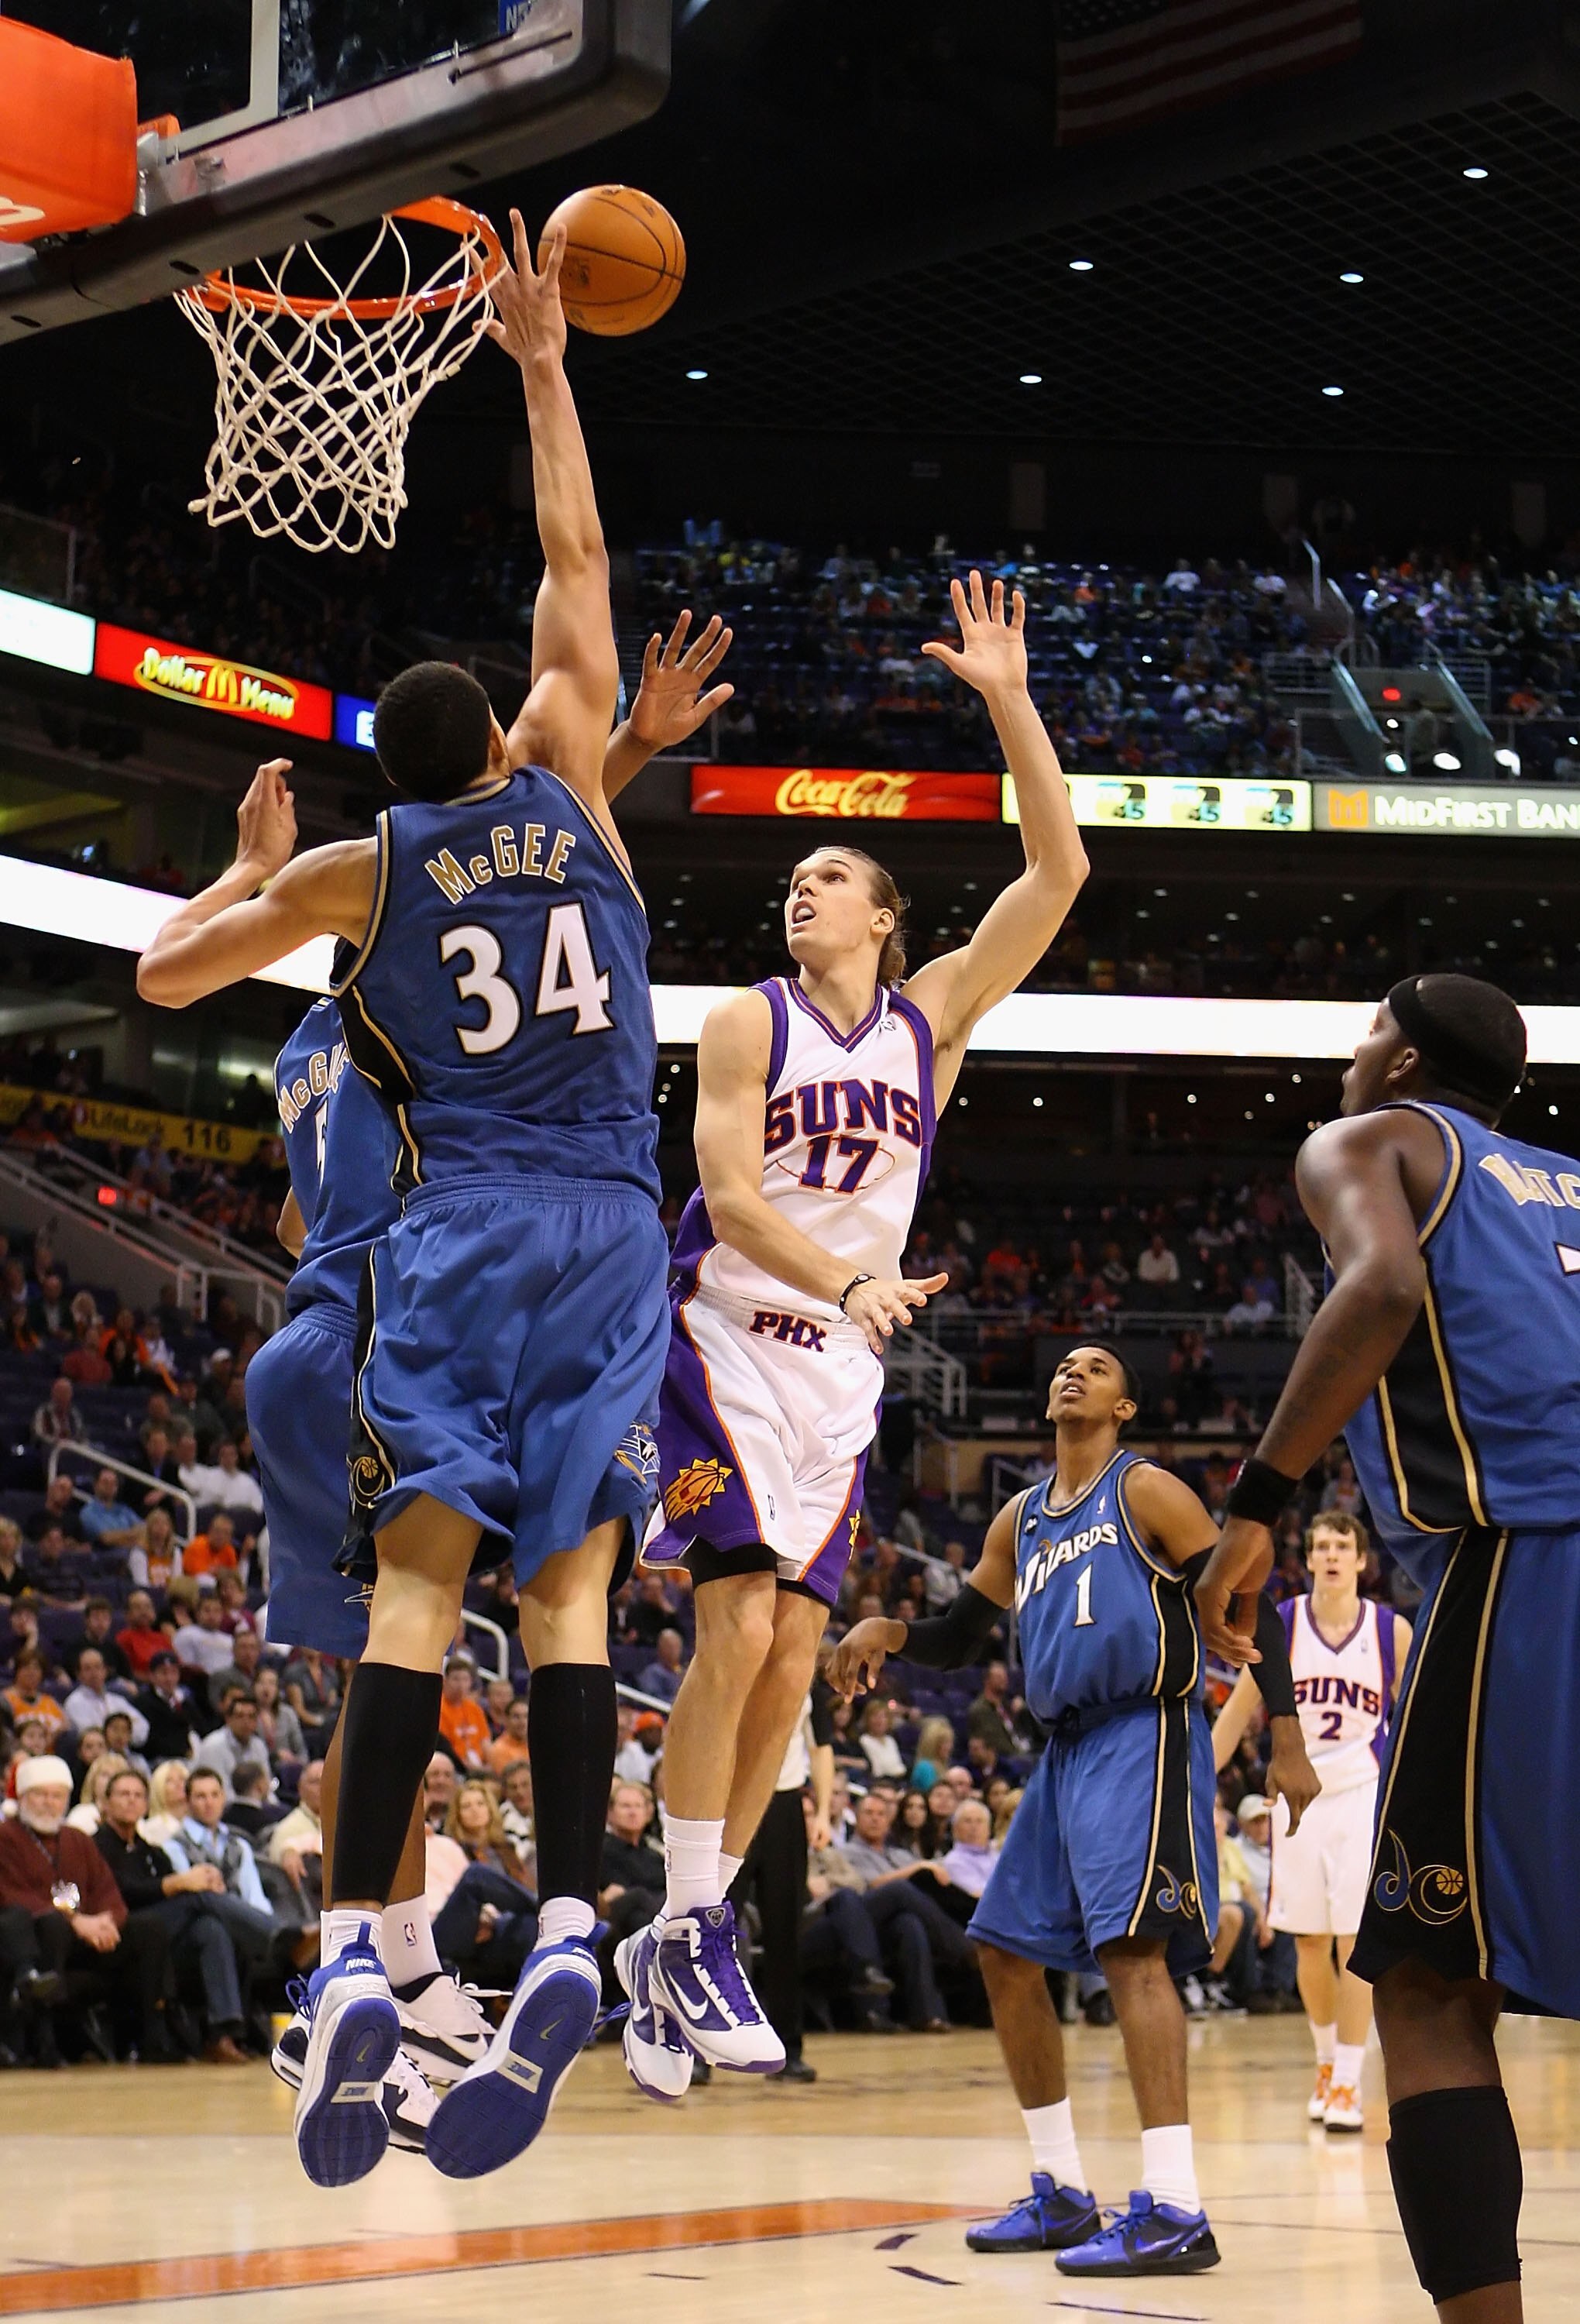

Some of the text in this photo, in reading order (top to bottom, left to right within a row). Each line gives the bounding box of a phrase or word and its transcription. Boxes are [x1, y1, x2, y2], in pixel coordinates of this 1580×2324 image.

[144, 647, 206, 694] Dollar
[240, 676, 294, 720] Menu
[775, 769, 917, 818] Coca-Cola
[1516, 798, 1580, 830] BAN
[424, 823, 576, 905] McGEE
[440, 902, 613, 1054] 34
[764, 1078, 923, 1157] SUNS
[798, 1133, 881, 1195] 17
[747, 1308, 828, 1353] PHX
[1073, 1563, 1095, 1627] 1
[1293, 1676, 1380, 1717] SUNS
[1319, 1710, 1342, 1741] 2
